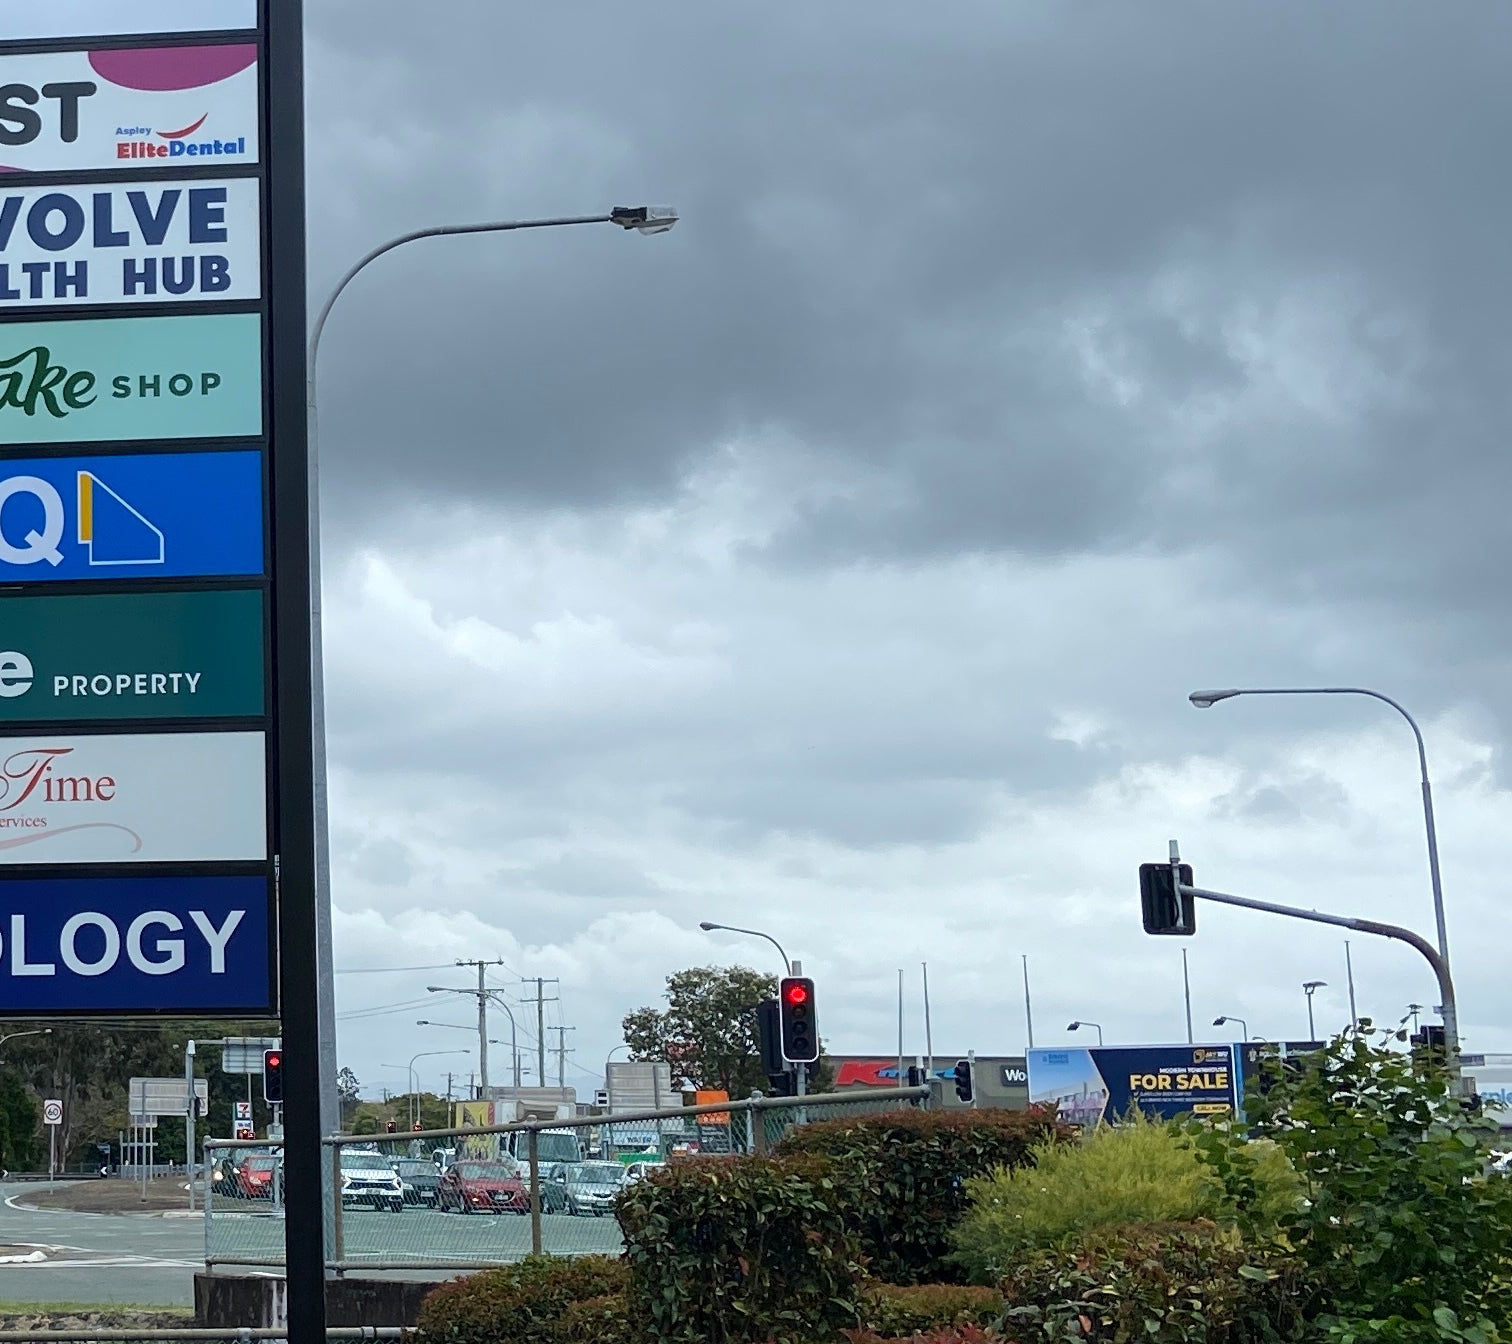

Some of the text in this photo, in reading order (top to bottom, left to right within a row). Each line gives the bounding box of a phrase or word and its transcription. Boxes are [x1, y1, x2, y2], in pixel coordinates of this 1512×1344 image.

[115, 126, 152, 136] Aspley
[122, 255, 232, 296] HUB
[111, 372, 221, 399] SHOP
[53, 672, 202, 697] PROPERTY
[1130, 1073, 1229, 1090] FOR SALE
[48, 1108, 59, 1116] 60
